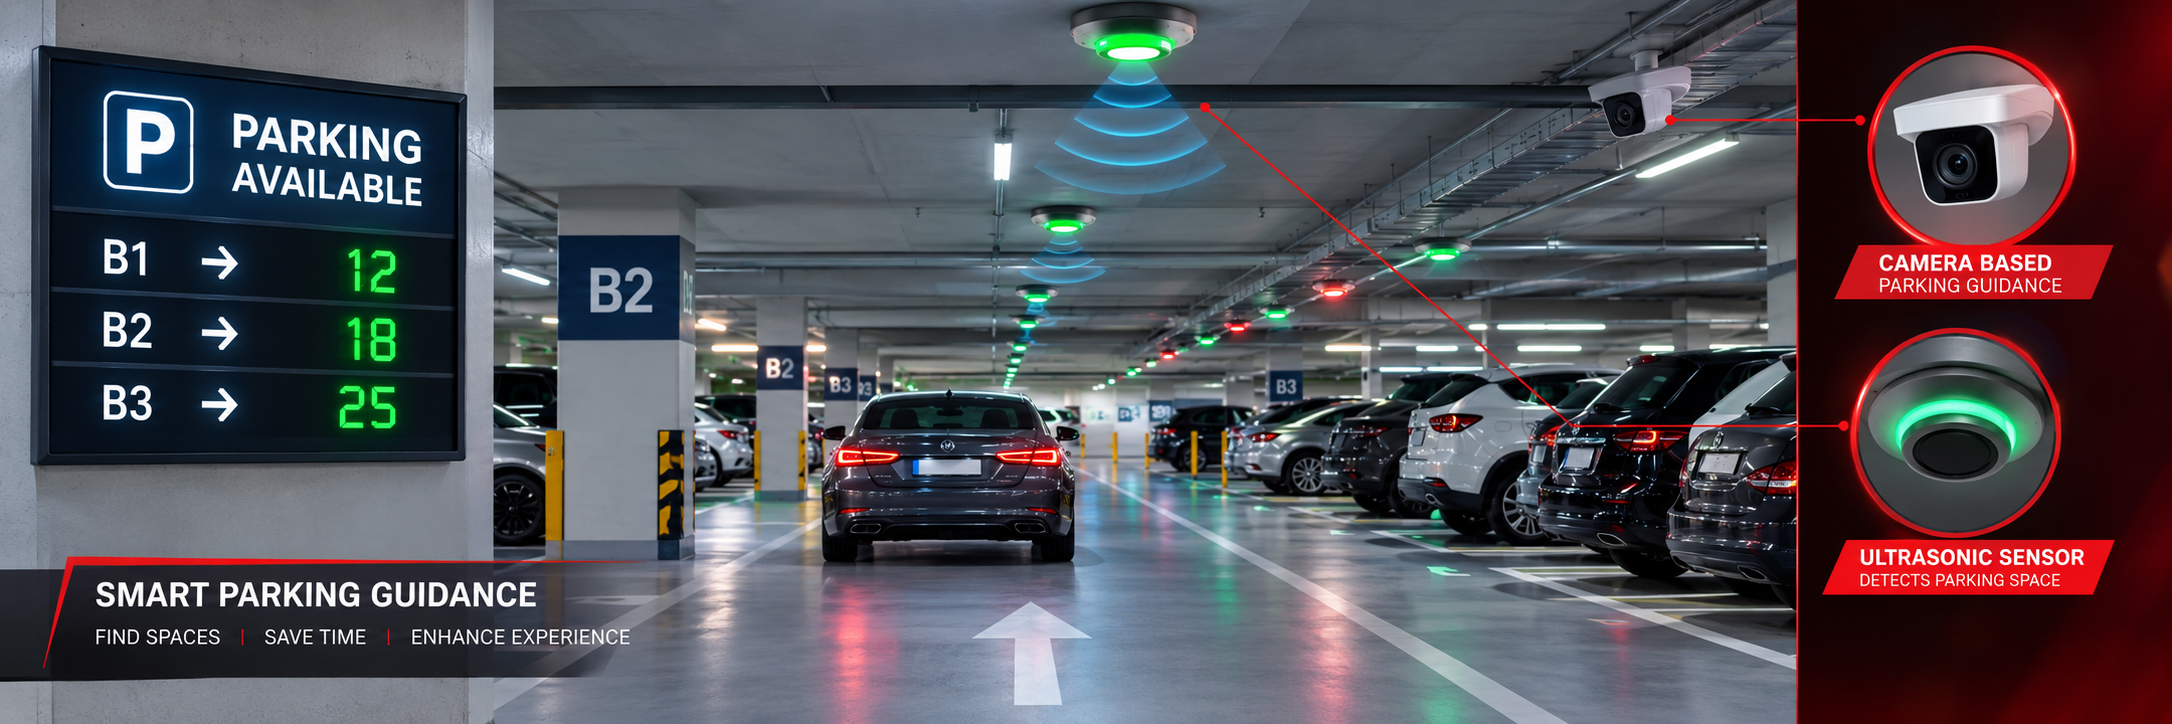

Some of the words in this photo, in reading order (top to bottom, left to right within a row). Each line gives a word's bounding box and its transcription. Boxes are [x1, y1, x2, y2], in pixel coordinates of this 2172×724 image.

[126, 108, 176, 175] P
[232, 113, 422, 165] PARKING
[231, 162, 422, 207] AVAILABLE
[103, 238, 147, 276] B1
[347, 248, 396, 294] 12
[590, 267, 653, 313] B2
[103, 311, 153, 349] B2
[347, 317, 396, 362] 18
[765, 357, 794, 379] B2
[829, 376, 852, 394] B3
[1276, 378, 1297, 395] B3
[103, 384, 153, 421] B3
[339, 385, 396, 429] 25
